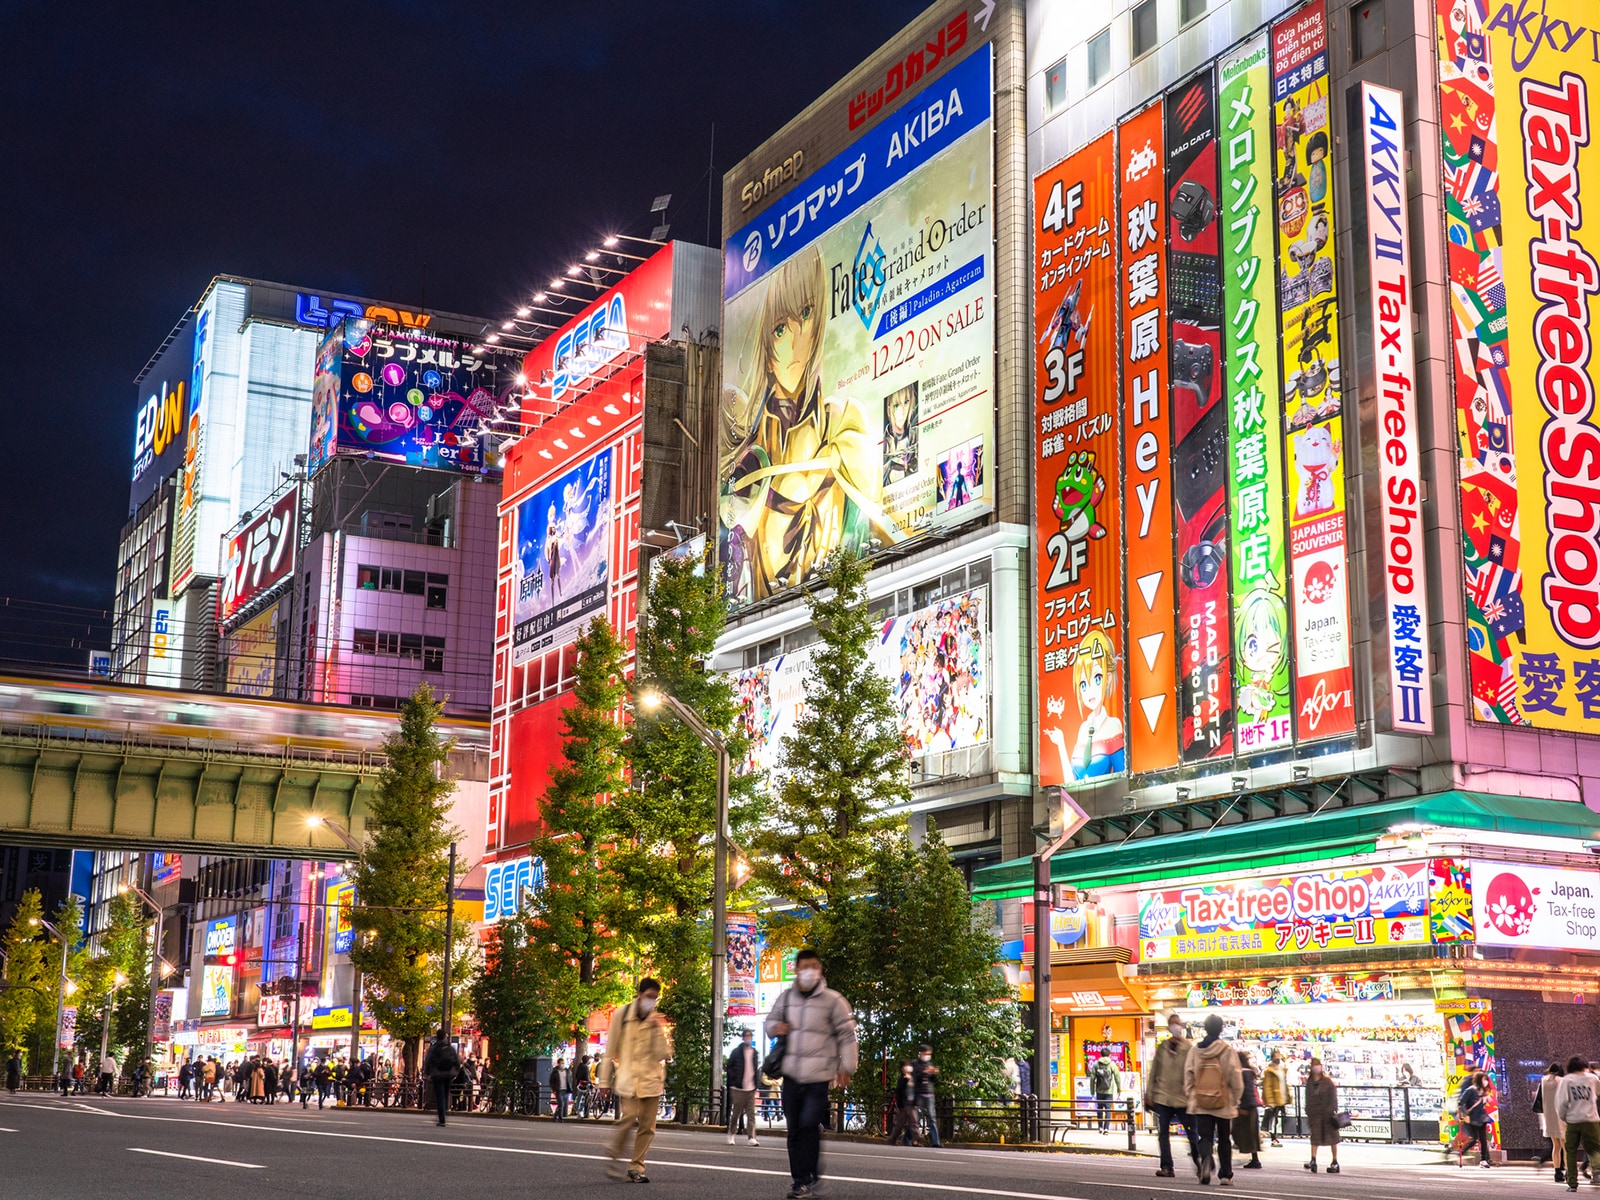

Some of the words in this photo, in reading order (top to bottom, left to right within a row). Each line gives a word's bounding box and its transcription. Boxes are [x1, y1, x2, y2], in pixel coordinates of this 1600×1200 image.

[1297, 12, 1321, 33] hàng
[849, 10, 968, 132] ビックカメラ
[1222, 47, 1267, 84] Melonbooks
[1277, 56, 1325, 95] 日本特産
[1171, 141, 1188, 158] MAD
[1190, 129, 1212, 149] CATZ
[1368, 92, 1402, 238] AKKY
[741, 150, 804, 213] Sofmap
[768, 152, 867, 249] ソフマップ
[886, 88, 964, 168] AKIBA
[1043, 180, 1084, 233] 4F
[830, 255, 867, 321] Fate
[873, 229, 926, 287] Grand
[927, 201, 986, 253] Order
[1040, 240, 1111, 292] オンラインゲーム
[1041, 217, 1110, 269] カードゲーム
[1524, 80, 1596, 415] Tax-free
[945, 265, 982, 294] Agateram
[373, 339, 498, 372] ラブメルシー
[551, 292, 631, 402] SEGA
[871, 329, 916, 381] 12.22
[917, 319, 943, 352] ON
[946, 296, 985, 338] SALE
[1228, 86, 1269, 582] メロンブックス秋葉原店
[1043, 347, 1085, 402] 3F
[1378, 275, 1412, 467] Tax-free
[1041, 398, 1088, 435] 対戦格闘
[1041, 413, 1113, 459] 麻雀・パズル
[1292, 516, 1344, 543] JAPANESE
[1292, 531, 1344, 555] SOUVENIR
[1388, 475, 1418, 596] Shop
[1546, 425, 1600, 642] Shop
[221, 505, 290, 604] オノデン
[1045, 532, 1089, 592] 2F
[519, 567, 544, 602] 原神
[1044, 589, 1091, 621] プライズ
[1044, 609, 1116, 647] レトロゲーム
[1190, 614, 1201, 661] Dare
[1204, 600, 1219, 665] MAD
[1043, 638, 1105, 673] 音楽ゲーム
[1191, 666, 1201, 687] to
[1193, 689, 1205, 742] Lead
[1207, 671, 1221, 748] CATZ
[1300, 679, 1342, 731] AKKY
[1240, 724, 1265, 747] 地下
[1271, 719, 1290, 743] 1F
[485, 856, 545, 920] SEGA
[1184, 887, 1289, 924] Tax-free
[1296, 879, 1366, 916] Shop
[1374, 883, 1416, 900] AKKY
[1546, 901, 1596, 919] Tax-free
[1551, 880, 1594, 900] Japan.
[1175, 933, 1263, 955] 海外向け電気製品
[1566, 920, 1597, 940] Shop
[1214, 987, 1248, 1000] Tax-free
[1250, 986, 1272, 998] Shop
[1363, 1125, 1390, 1134] CITIZEN
